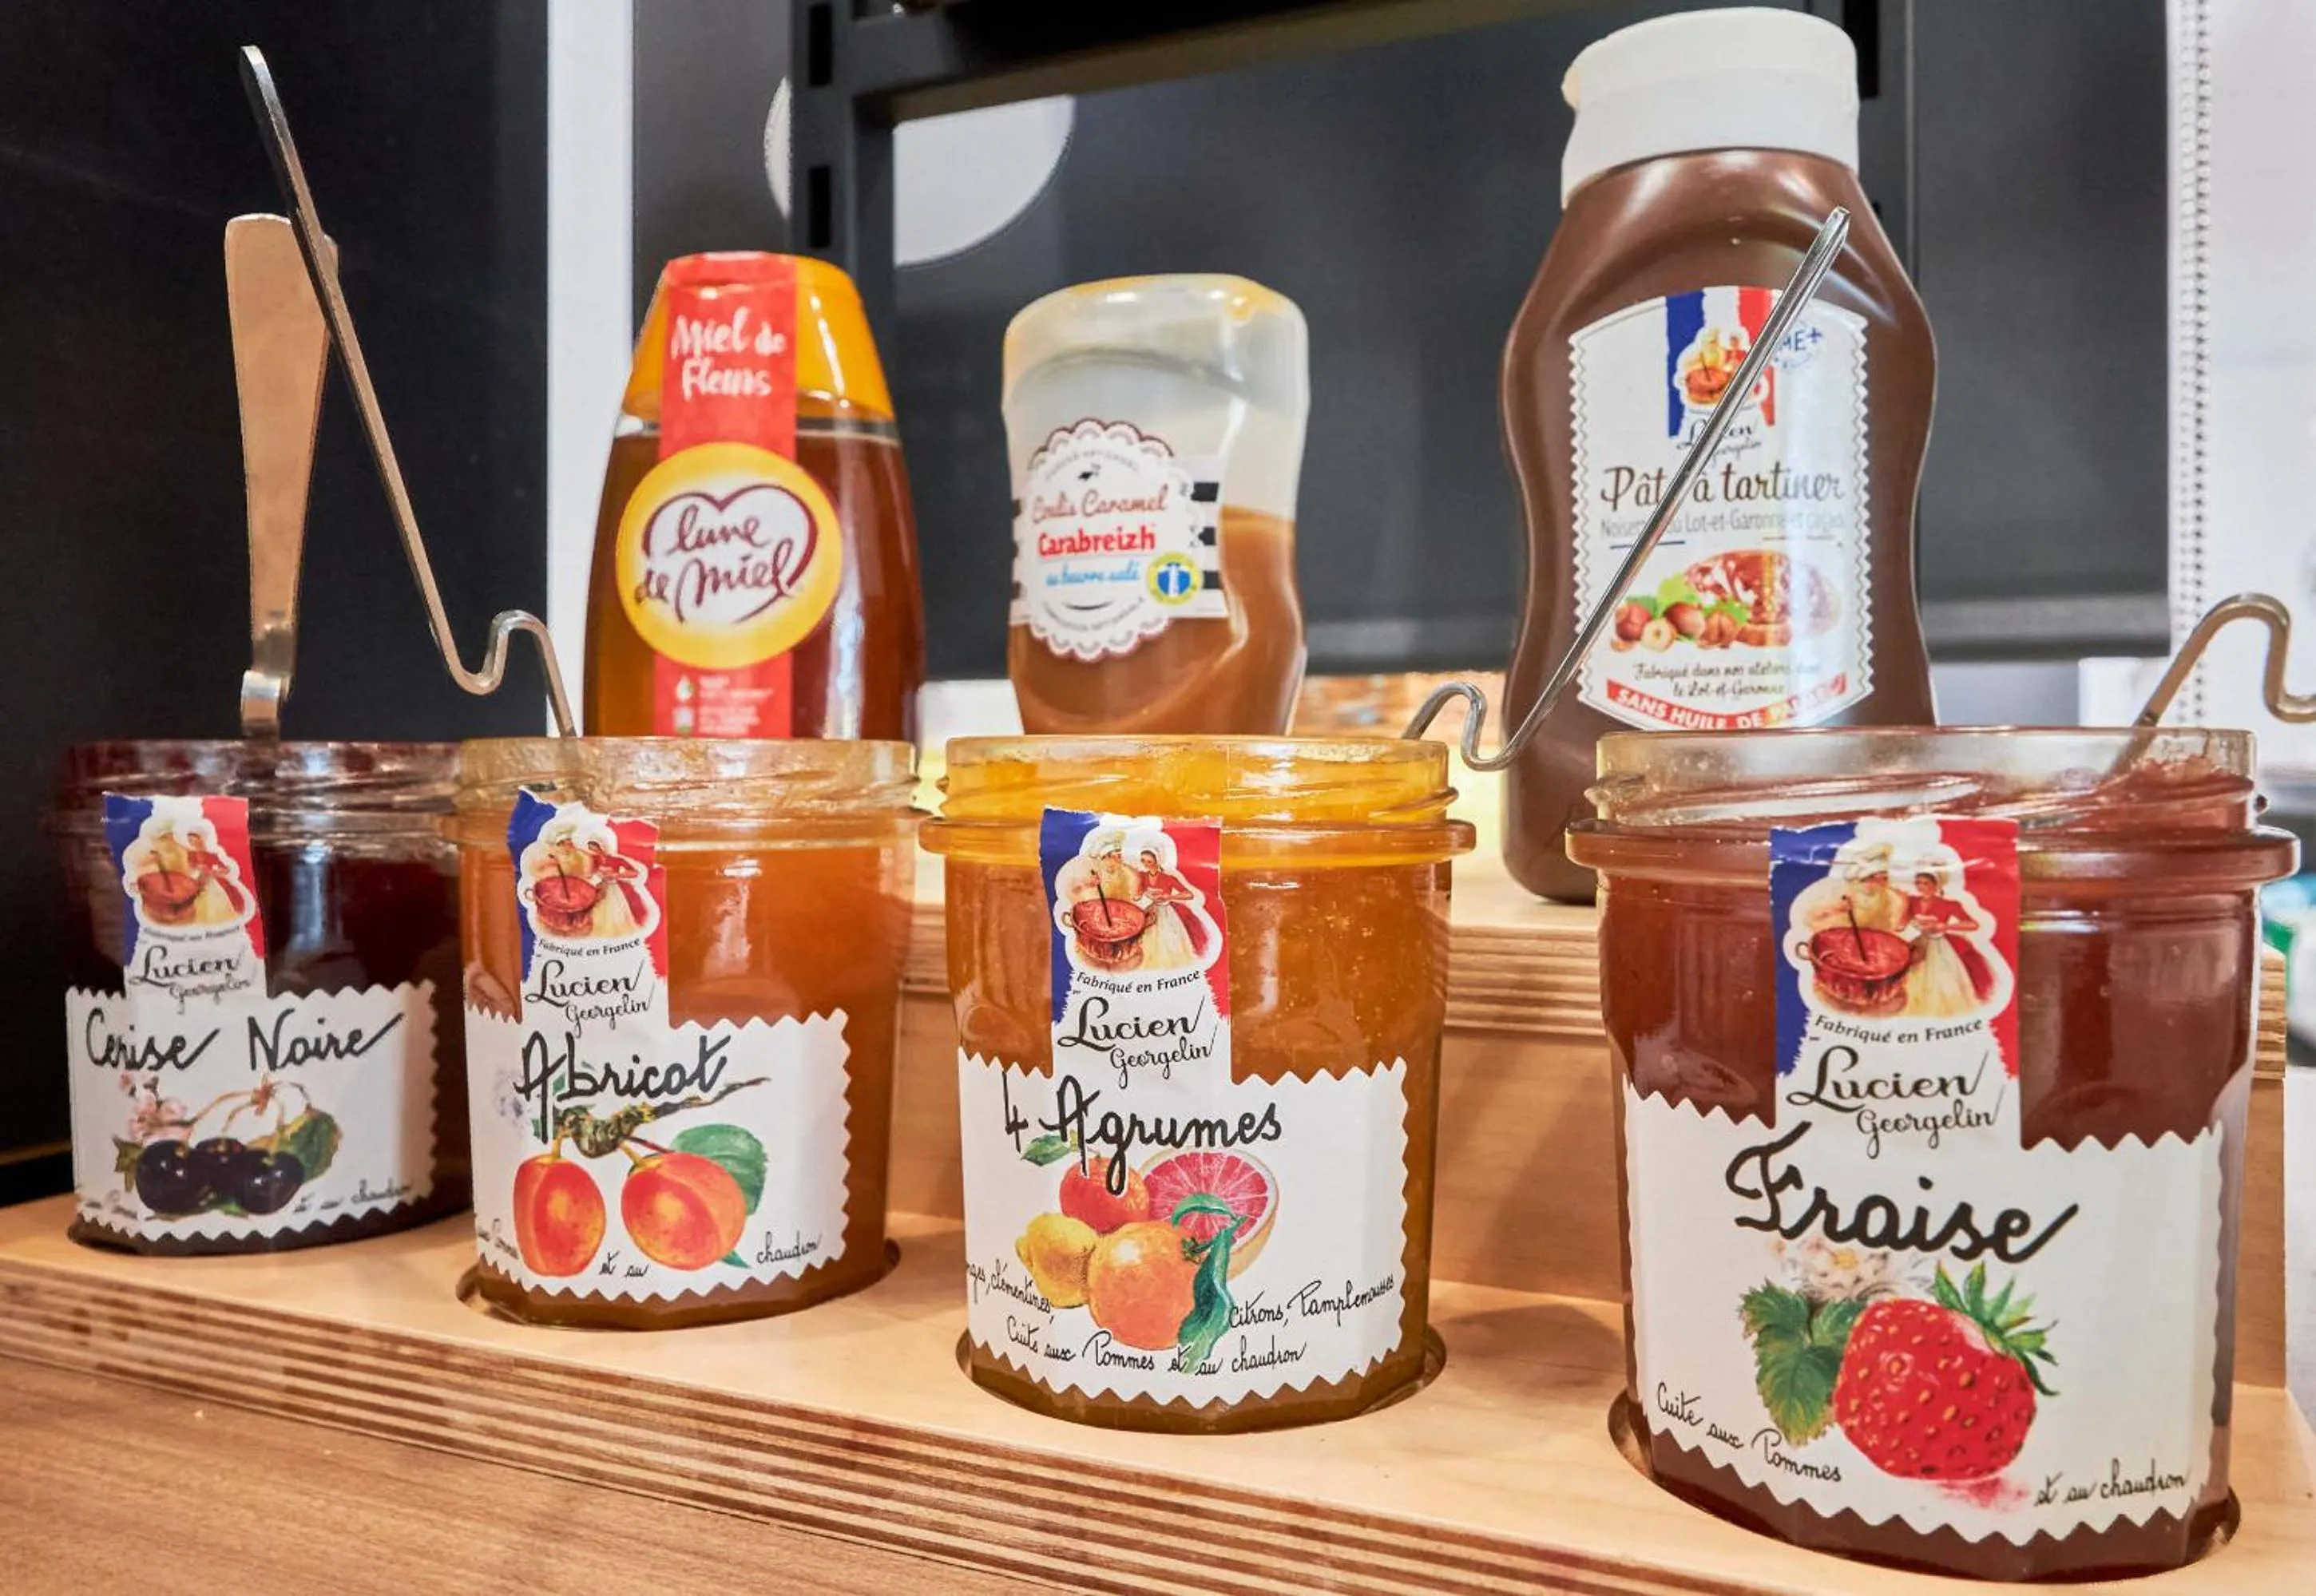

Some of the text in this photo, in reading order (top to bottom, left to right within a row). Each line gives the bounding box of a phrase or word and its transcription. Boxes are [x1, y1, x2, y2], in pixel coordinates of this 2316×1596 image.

[671, 307, 752, 360] Miel
[1081, 484, 1168, 517] Caramel
[1600, 466, 1668, 512] Pât
[1722, 461, 1846, 503] tartiner
[1038, 524, 1156, 556] Carabreizh
[1616, 687, 1764, 730] SANS HUILE DE
[129, 945, 246, 988] Lucien
[538, 938, 640, 958] Fabriqué en France
[524, 959, 645, 1008] Lucien
[1077, 970, 1200, 995] Fabriqué en France
[565, 980, 656, 1039] Georgelin
[1057, 996, 1206, 1052] Lucien
[1815, 1015, 1982, 1044] Fabriqué en France
[86, 1007, 405, 1071] Cerise Noire
[1110, 1022, 1219, 1090] Georgelin
[513, 1031, 732, 1144] Abricot
[1786, 1045, 1990, 1113] Lucien
[1001, 1070, 1283, 1197] 4 Agrumes
[1856, 1084, 2006, 1160] Georgelin
[1725, 1120, 2080, 1264] Fraise
[599, 1249, 621, 1275] et
[625, 1264, 649, 1277] au
[1006, 1316, 1307, 1376] Cuits aux Pommes et au chaudron
[1657, 1381, 1842, 1482] Cuite aux Pommes
[2033, 1457, 2191, 1507] et au chaudron
